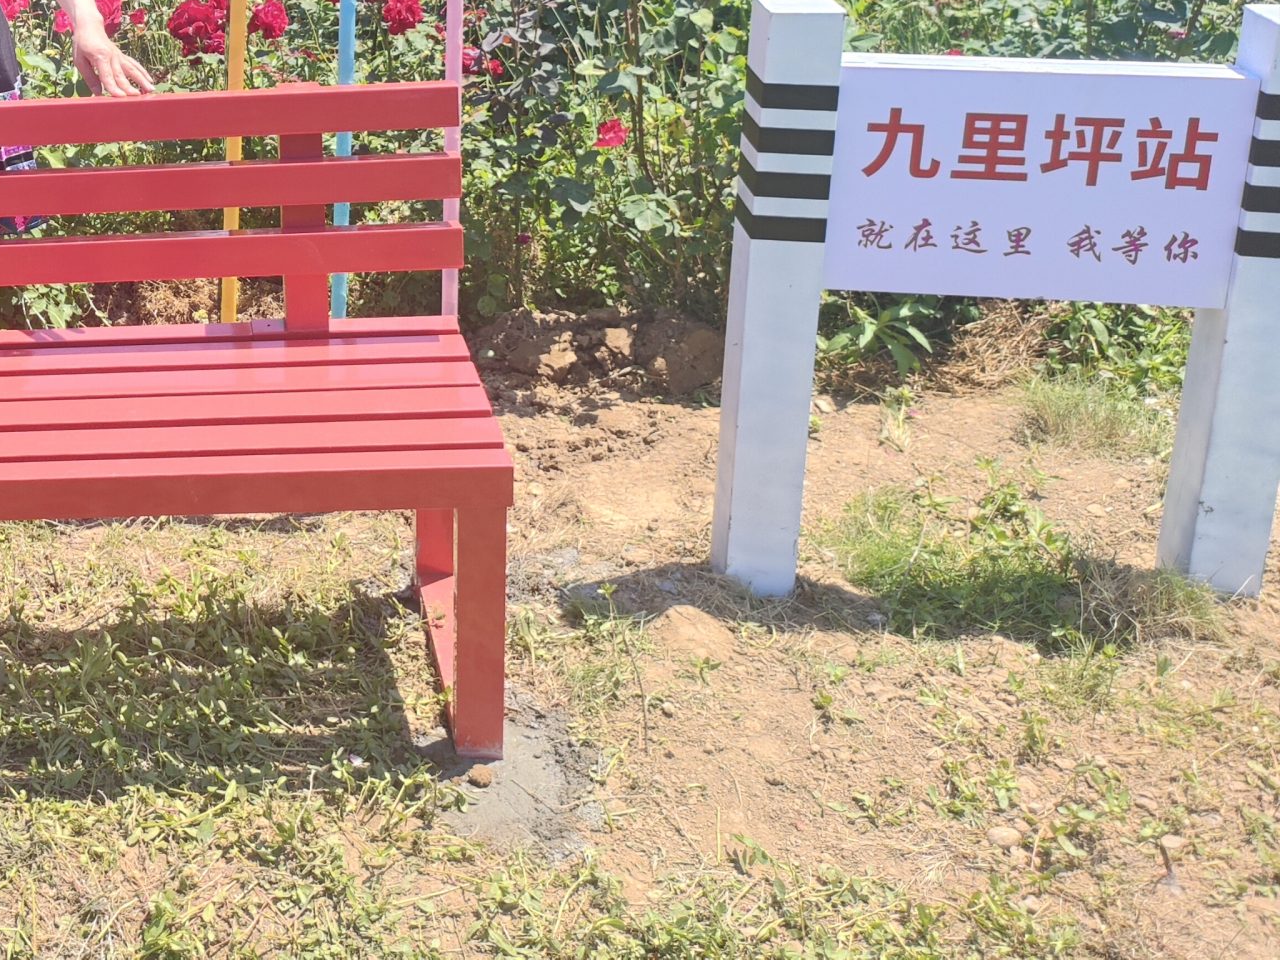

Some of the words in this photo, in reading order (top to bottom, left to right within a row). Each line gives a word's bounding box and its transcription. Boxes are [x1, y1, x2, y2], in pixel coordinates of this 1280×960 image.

[862, 107, 1219, 191] 九里坪站
[856, 217, 1033, 257] 就在这里
[1067, 224, 1200, 266] 我等你
